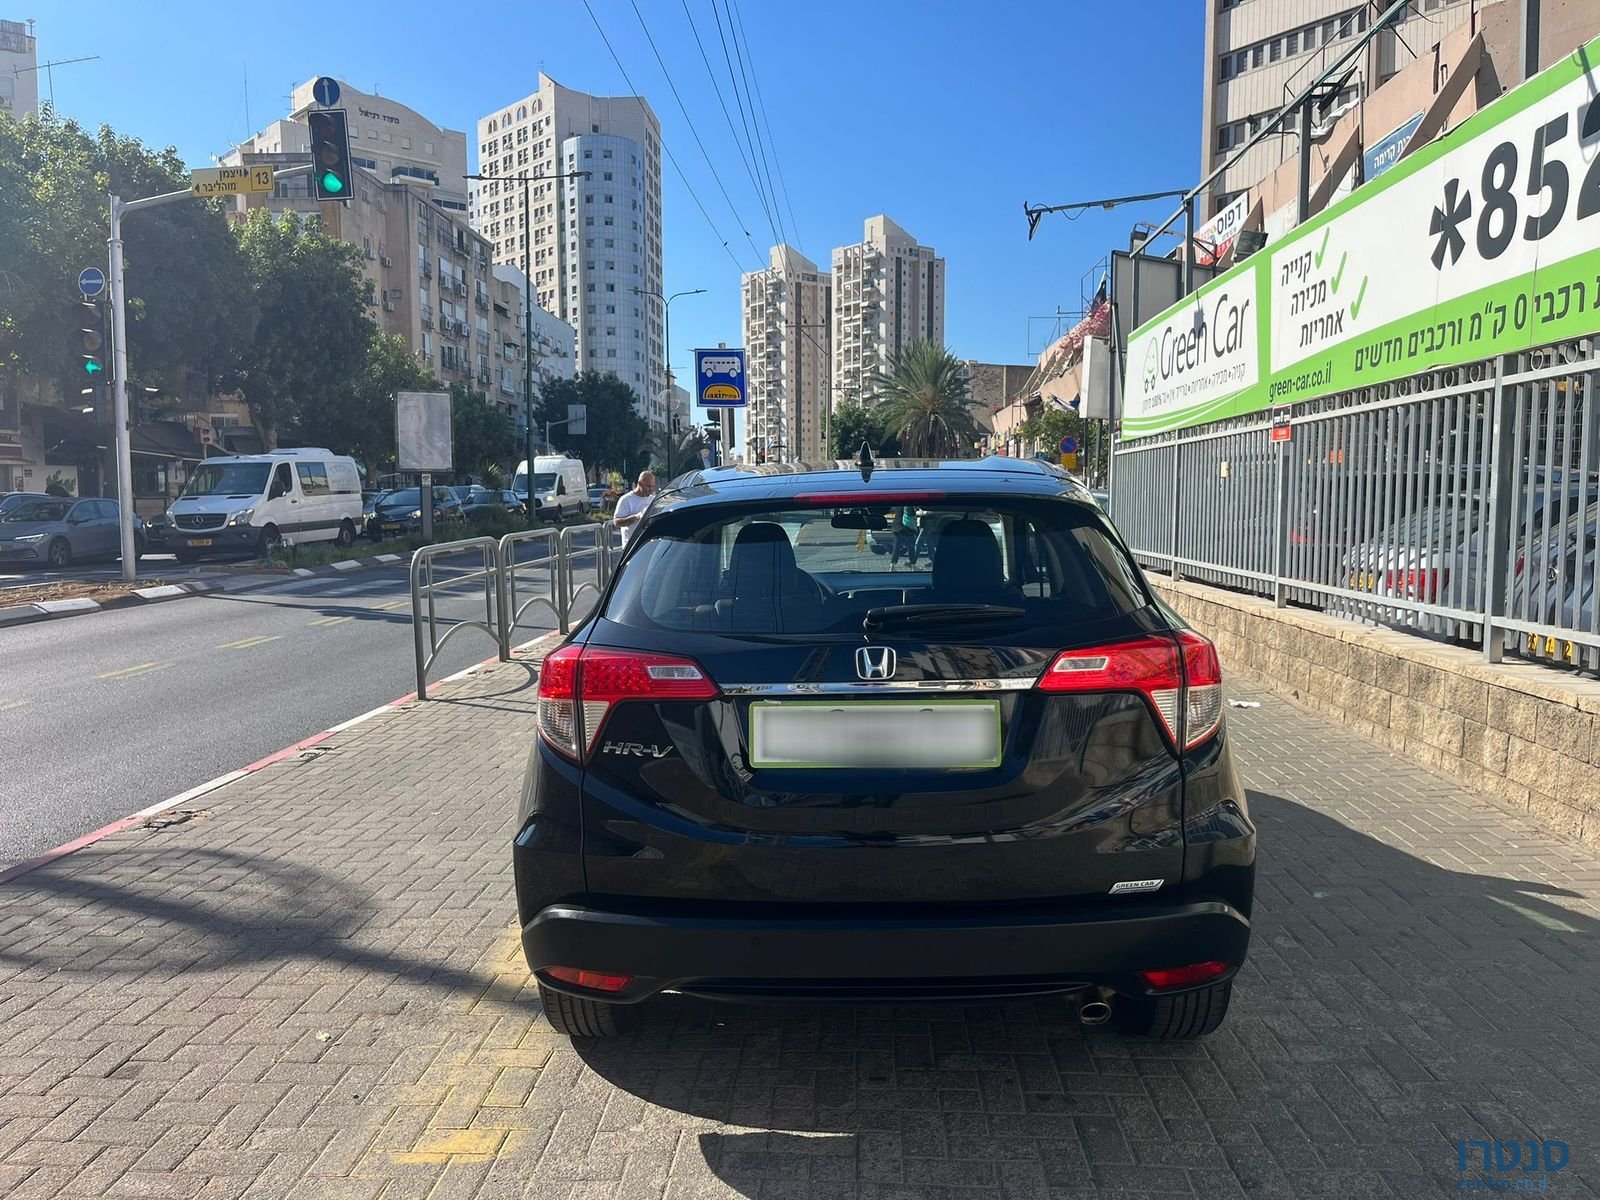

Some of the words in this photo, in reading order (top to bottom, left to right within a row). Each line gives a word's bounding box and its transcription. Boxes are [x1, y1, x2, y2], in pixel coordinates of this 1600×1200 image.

[202, 180, 237, 192] מוהליבר
[220, 169, 242, 181] ויצמן
[255, 171, 270, 185] 13
[1216, 202, 1242, 235] דפוס
[1281, 250, 1312, 287] קנייה
[1290, 279, 1327, 316] מכירה
[1513, 293, 1527, 330] 0
[1534, 281, 1586, 324] רכבי
[1160, 320, 1208, 381] Green
[1213, 293, 1250, 358] Car
[1299, 308, 1345, 348] אחריות
[1407, 318, 1463, 358] ורכבים
[1354, 337, 1402, 372] חדשים
[1269, 360, 1332, 403] green-car.co.il
[602, 740, 674, 758] HR-V
